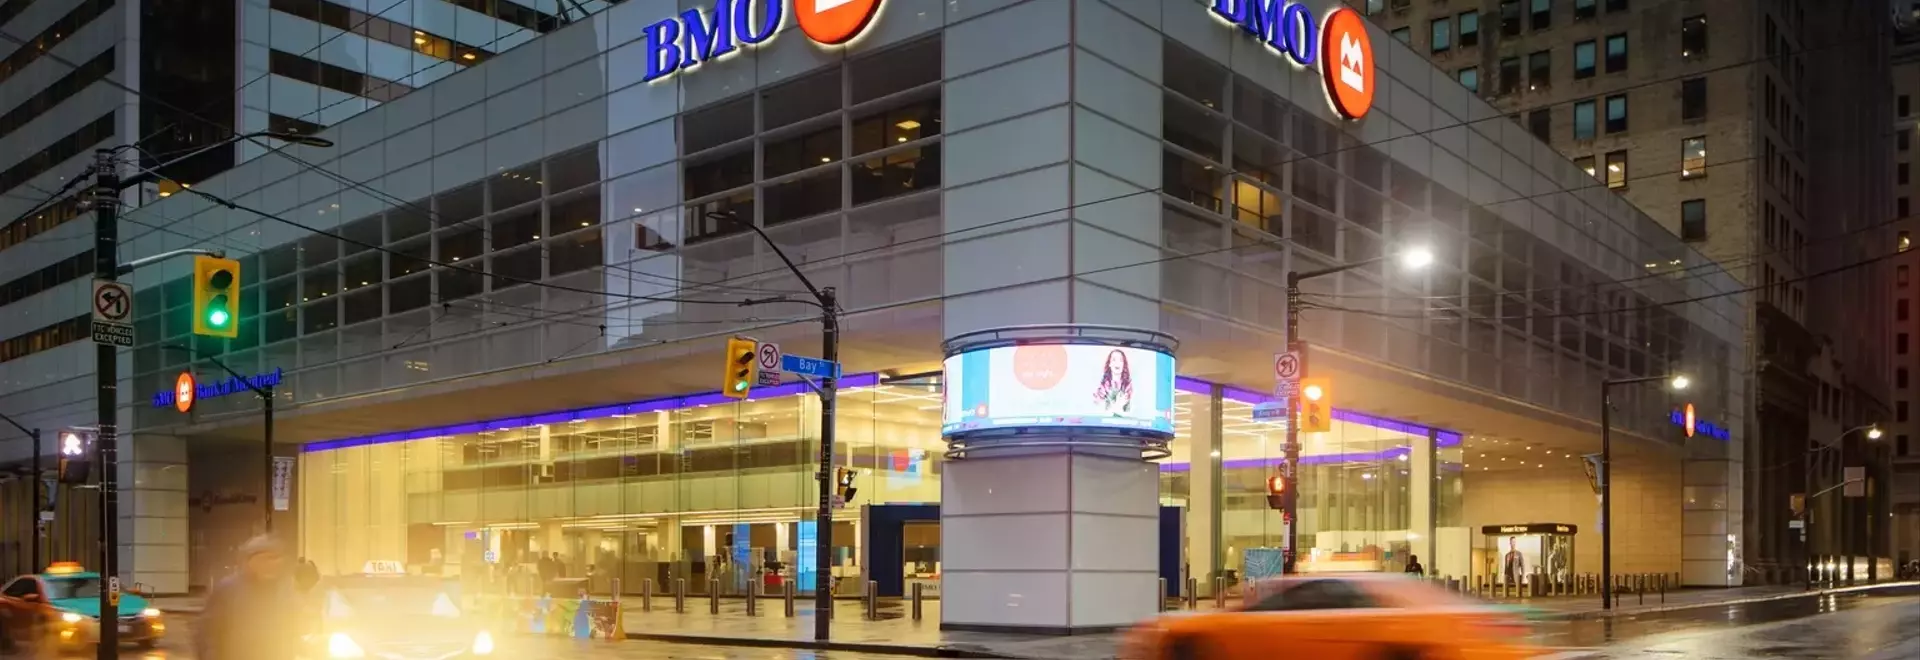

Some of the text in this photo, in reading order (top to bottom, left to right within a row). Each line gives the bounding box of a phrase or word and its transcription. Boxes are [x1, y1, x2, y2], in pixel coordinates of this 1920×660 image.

[642, 0, 783, 82] BMO
[1211, 0, 1317, 65] MO
[94, 333, 131, 344] EXCEPTED
[799, 358, 817, 374] Bay
